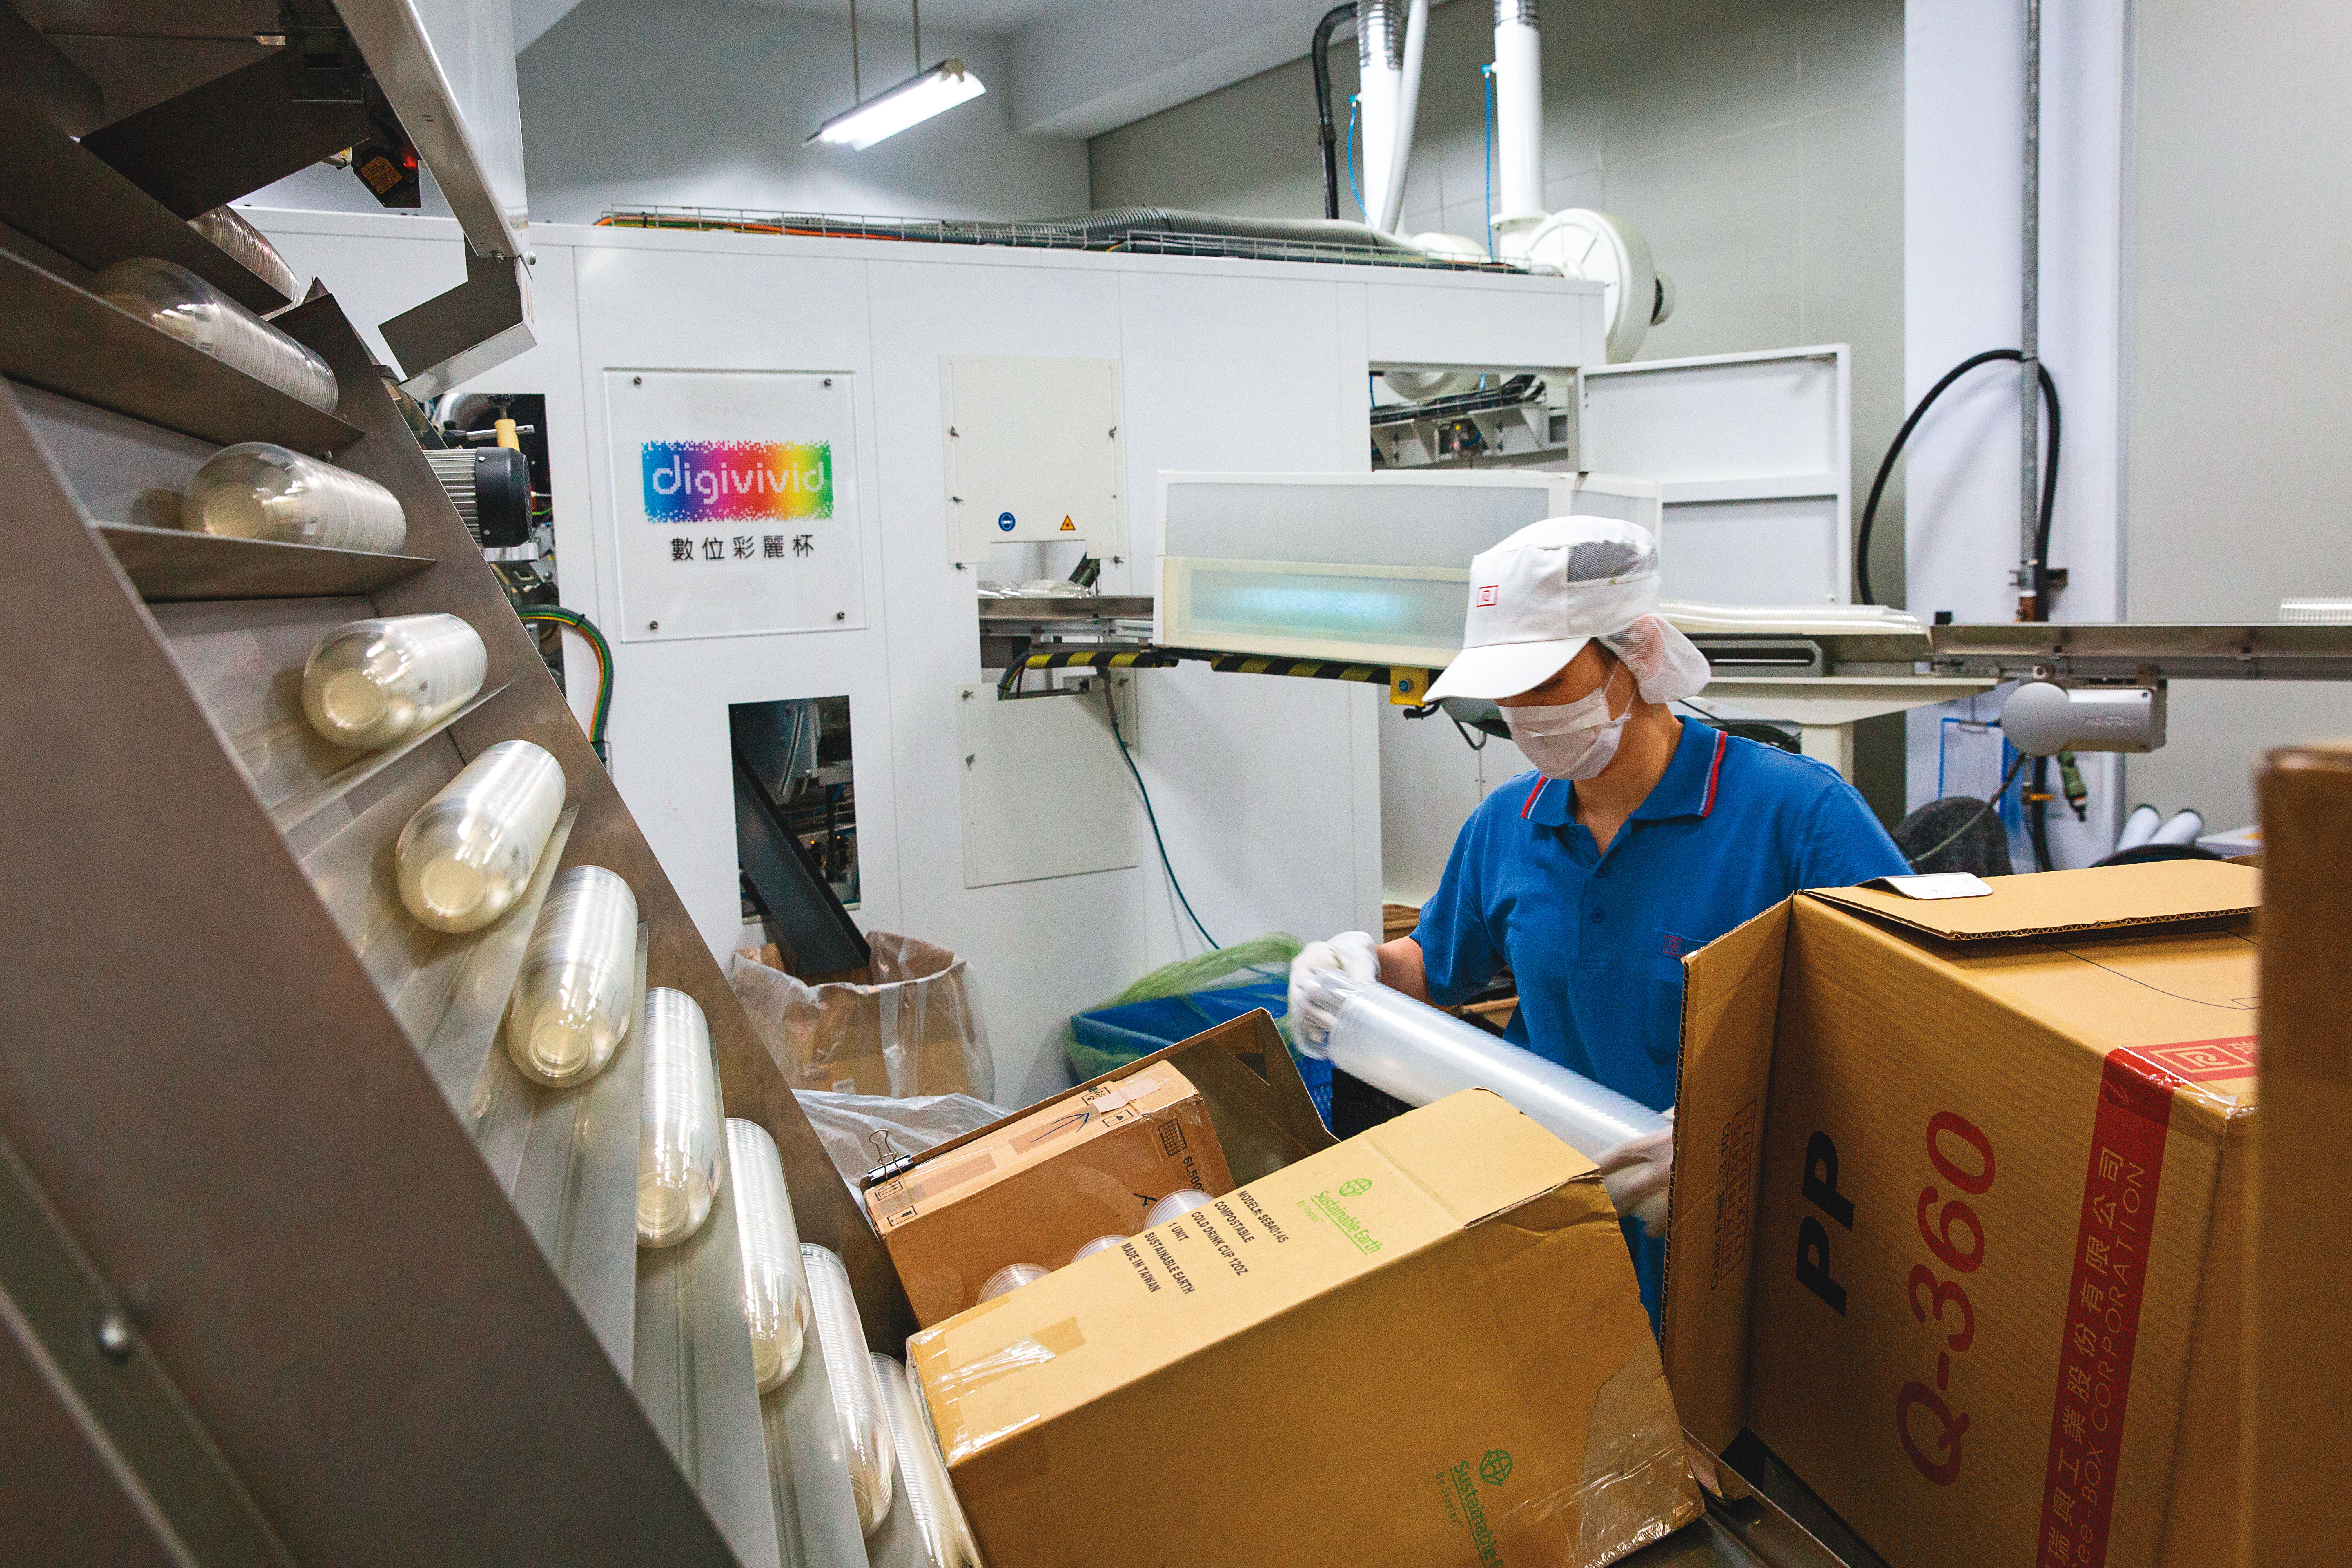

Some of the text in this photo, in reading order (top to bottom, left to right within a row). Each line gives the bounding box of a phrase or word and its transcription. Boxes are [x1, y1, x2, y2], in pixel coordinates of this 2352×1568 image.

[653, 455, 824, 504] digivivid
[671, 535, 814, 561] 數位彩麗杯
[1183, 1156, 1204, 1192] 6L500
[1719, 1122, 1730, 1175] 3.103
[1172, 1225, 1189, 1241] UNIT
[1192, 1212, 1209, 1227] COLD
[1203, 1226, 1225, 1247] DRINK
[1218, 1245, 1235, 1257] CUP
[1214, 1201, 1255, 1243] COMPOSTABLE
[1258, 1214, 1289, 1243] SEB40145
[1314, 1190, 1383, 1254] Sustainable Earth
[1715, 1191, 1724, 1235] Feet
[1797, 1130, 1855, 1317] PP
[1121, 1243, 1161, 1292] MADE IN TAIWAN
[1145, 1232, 1180, 1273] SUSTAINABLE
[1173, 1271, 1195, 1294] EARTH
[1711, 1235, 1722, 1290] Cubic
[1896, 1111, 1996, 1487] Q-360
[2047, 1147, 2123, 1566] 瑞興工業股份有限公司
[2072, 1162, 2145, 1568] ee-BOX CORPORATION
[1454, 1460, 1497, 1561] Sustainable
